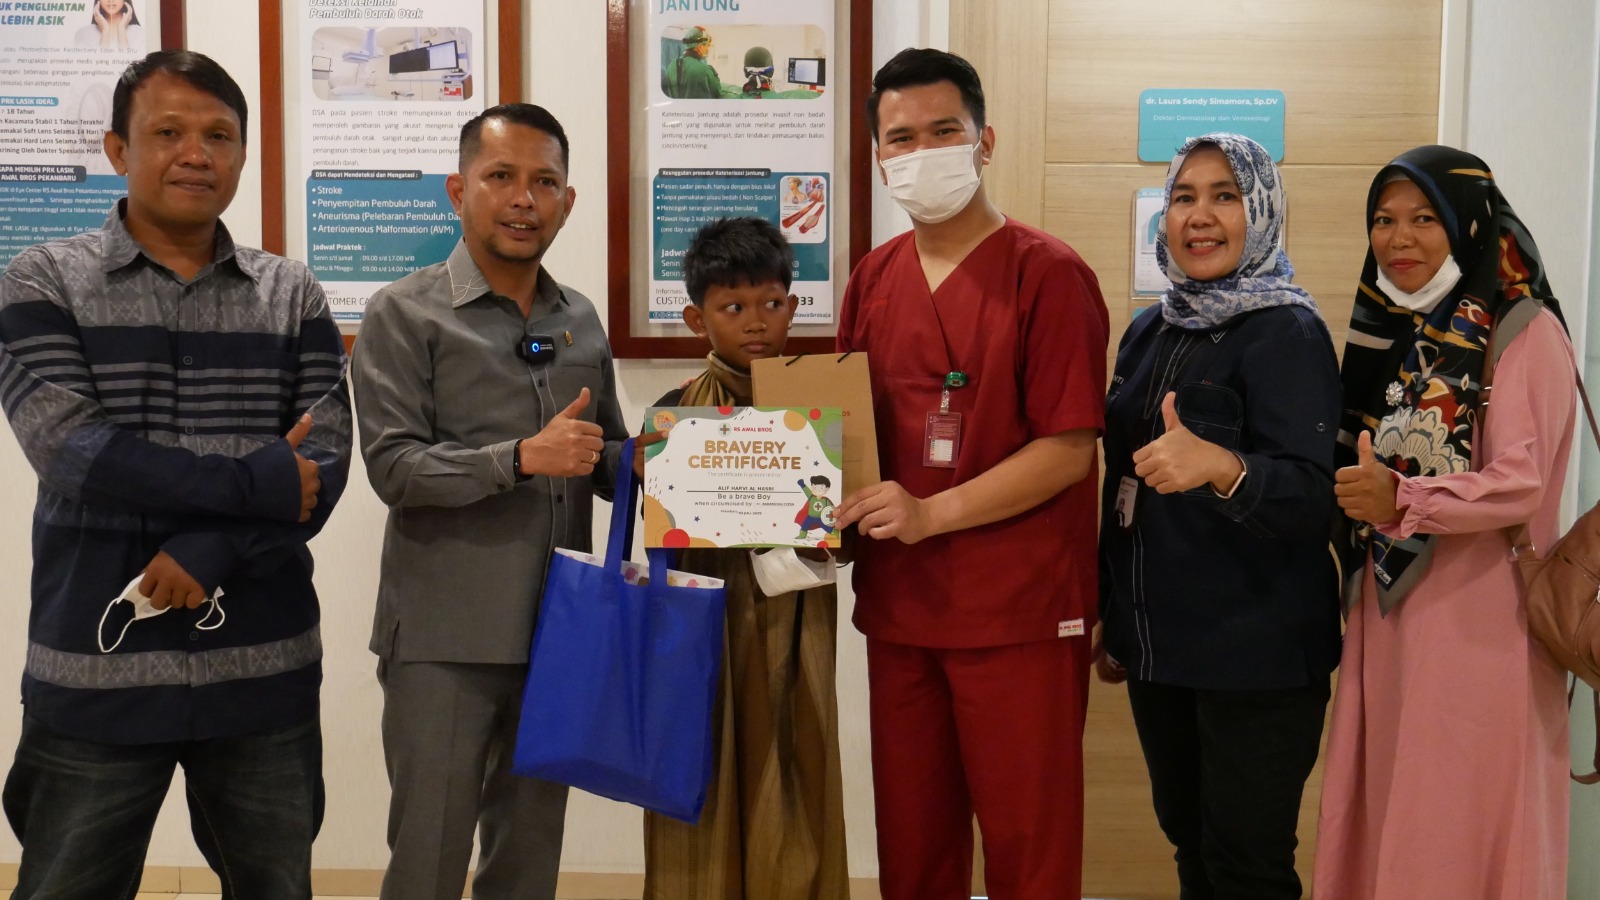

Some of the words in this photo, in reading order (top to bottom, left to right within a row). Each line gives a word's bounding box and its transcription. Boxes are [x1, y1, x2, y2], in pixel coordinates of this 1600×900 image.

[15, 2, 85, 11] PENGLIHATAN
[659, 0, 740, 14] JANTUNG
[309, 8, 362, 19] Pembuluh
[364, 8, 394, 19] Darah
[397, 8, 424, 19] Otak
[1, 15, 35, 25] LEBIH
[37, 16, 65, 26] ASIK
[1146, 98, 1157, 106] dr.
[1159, 98, 1181, 106] Laura
[1183, 98, 1207, 106] Sendy
[1210, 98, 1252, 106] Simamora,
[1254, 98, 1278, 106] Sp.DV
[317, 186, 343, 195] Stroke
[318, 199, 370, 209] Penyempitan
[371, 199, 411, 209] Pembuluh
[414, 199, 437, 209] Darah
[318, 212, 360, 221] Aneurisma
[362, 212, 405, 221] (Pelebaran
[406, 212, 446, 221] Pembuluh
[318, 225, 374, 234] Arteriovenous
[376, 225, 428, 234] Malformation
[430, 225, 454, 234] (AVM)
[704, 440, 786, 454] BRAVERY
[688, 455, 802, 470] CERTIFICATE
